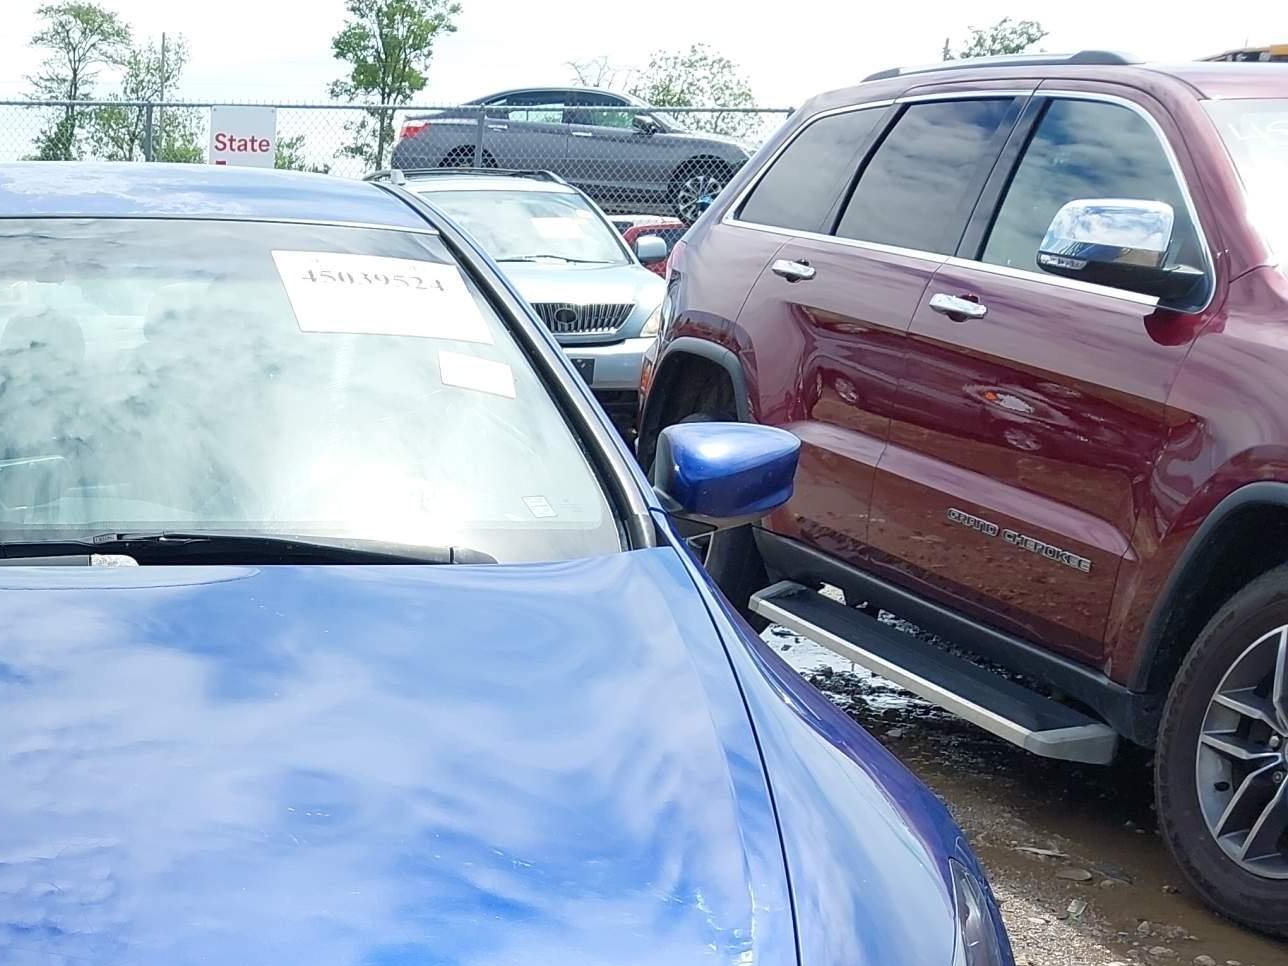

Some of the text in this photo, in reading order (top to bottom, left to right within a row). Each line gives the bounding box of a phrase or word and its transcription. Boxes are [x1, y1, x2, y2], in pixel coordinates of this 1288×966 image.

[214, 133, 270, 152] State
[947, 507, 1092, 573] GRAND CHEROKEE
